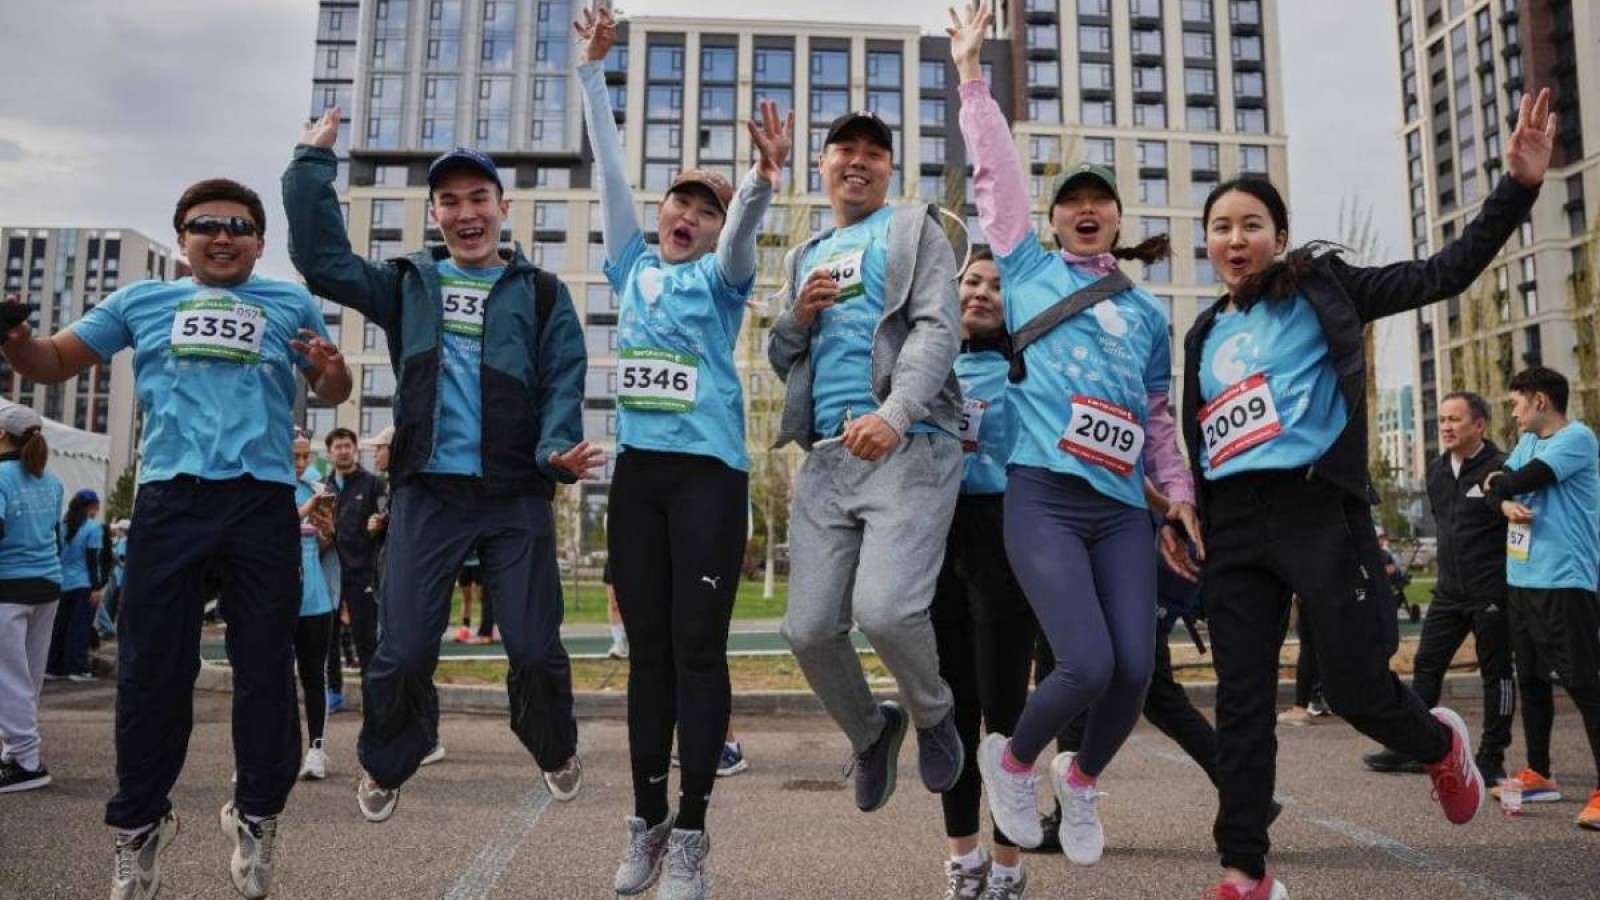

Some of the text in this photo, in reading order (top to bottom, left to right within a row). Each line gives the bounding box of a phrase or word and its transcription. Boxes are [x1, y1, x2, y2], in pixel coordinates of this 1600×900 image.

[182, 317, 256, 344] 5352
[623, 366, 689, 391] 5346
[1075, 414, 1135, 452] 2019
[1207, 396, 1266, 449] 2009
